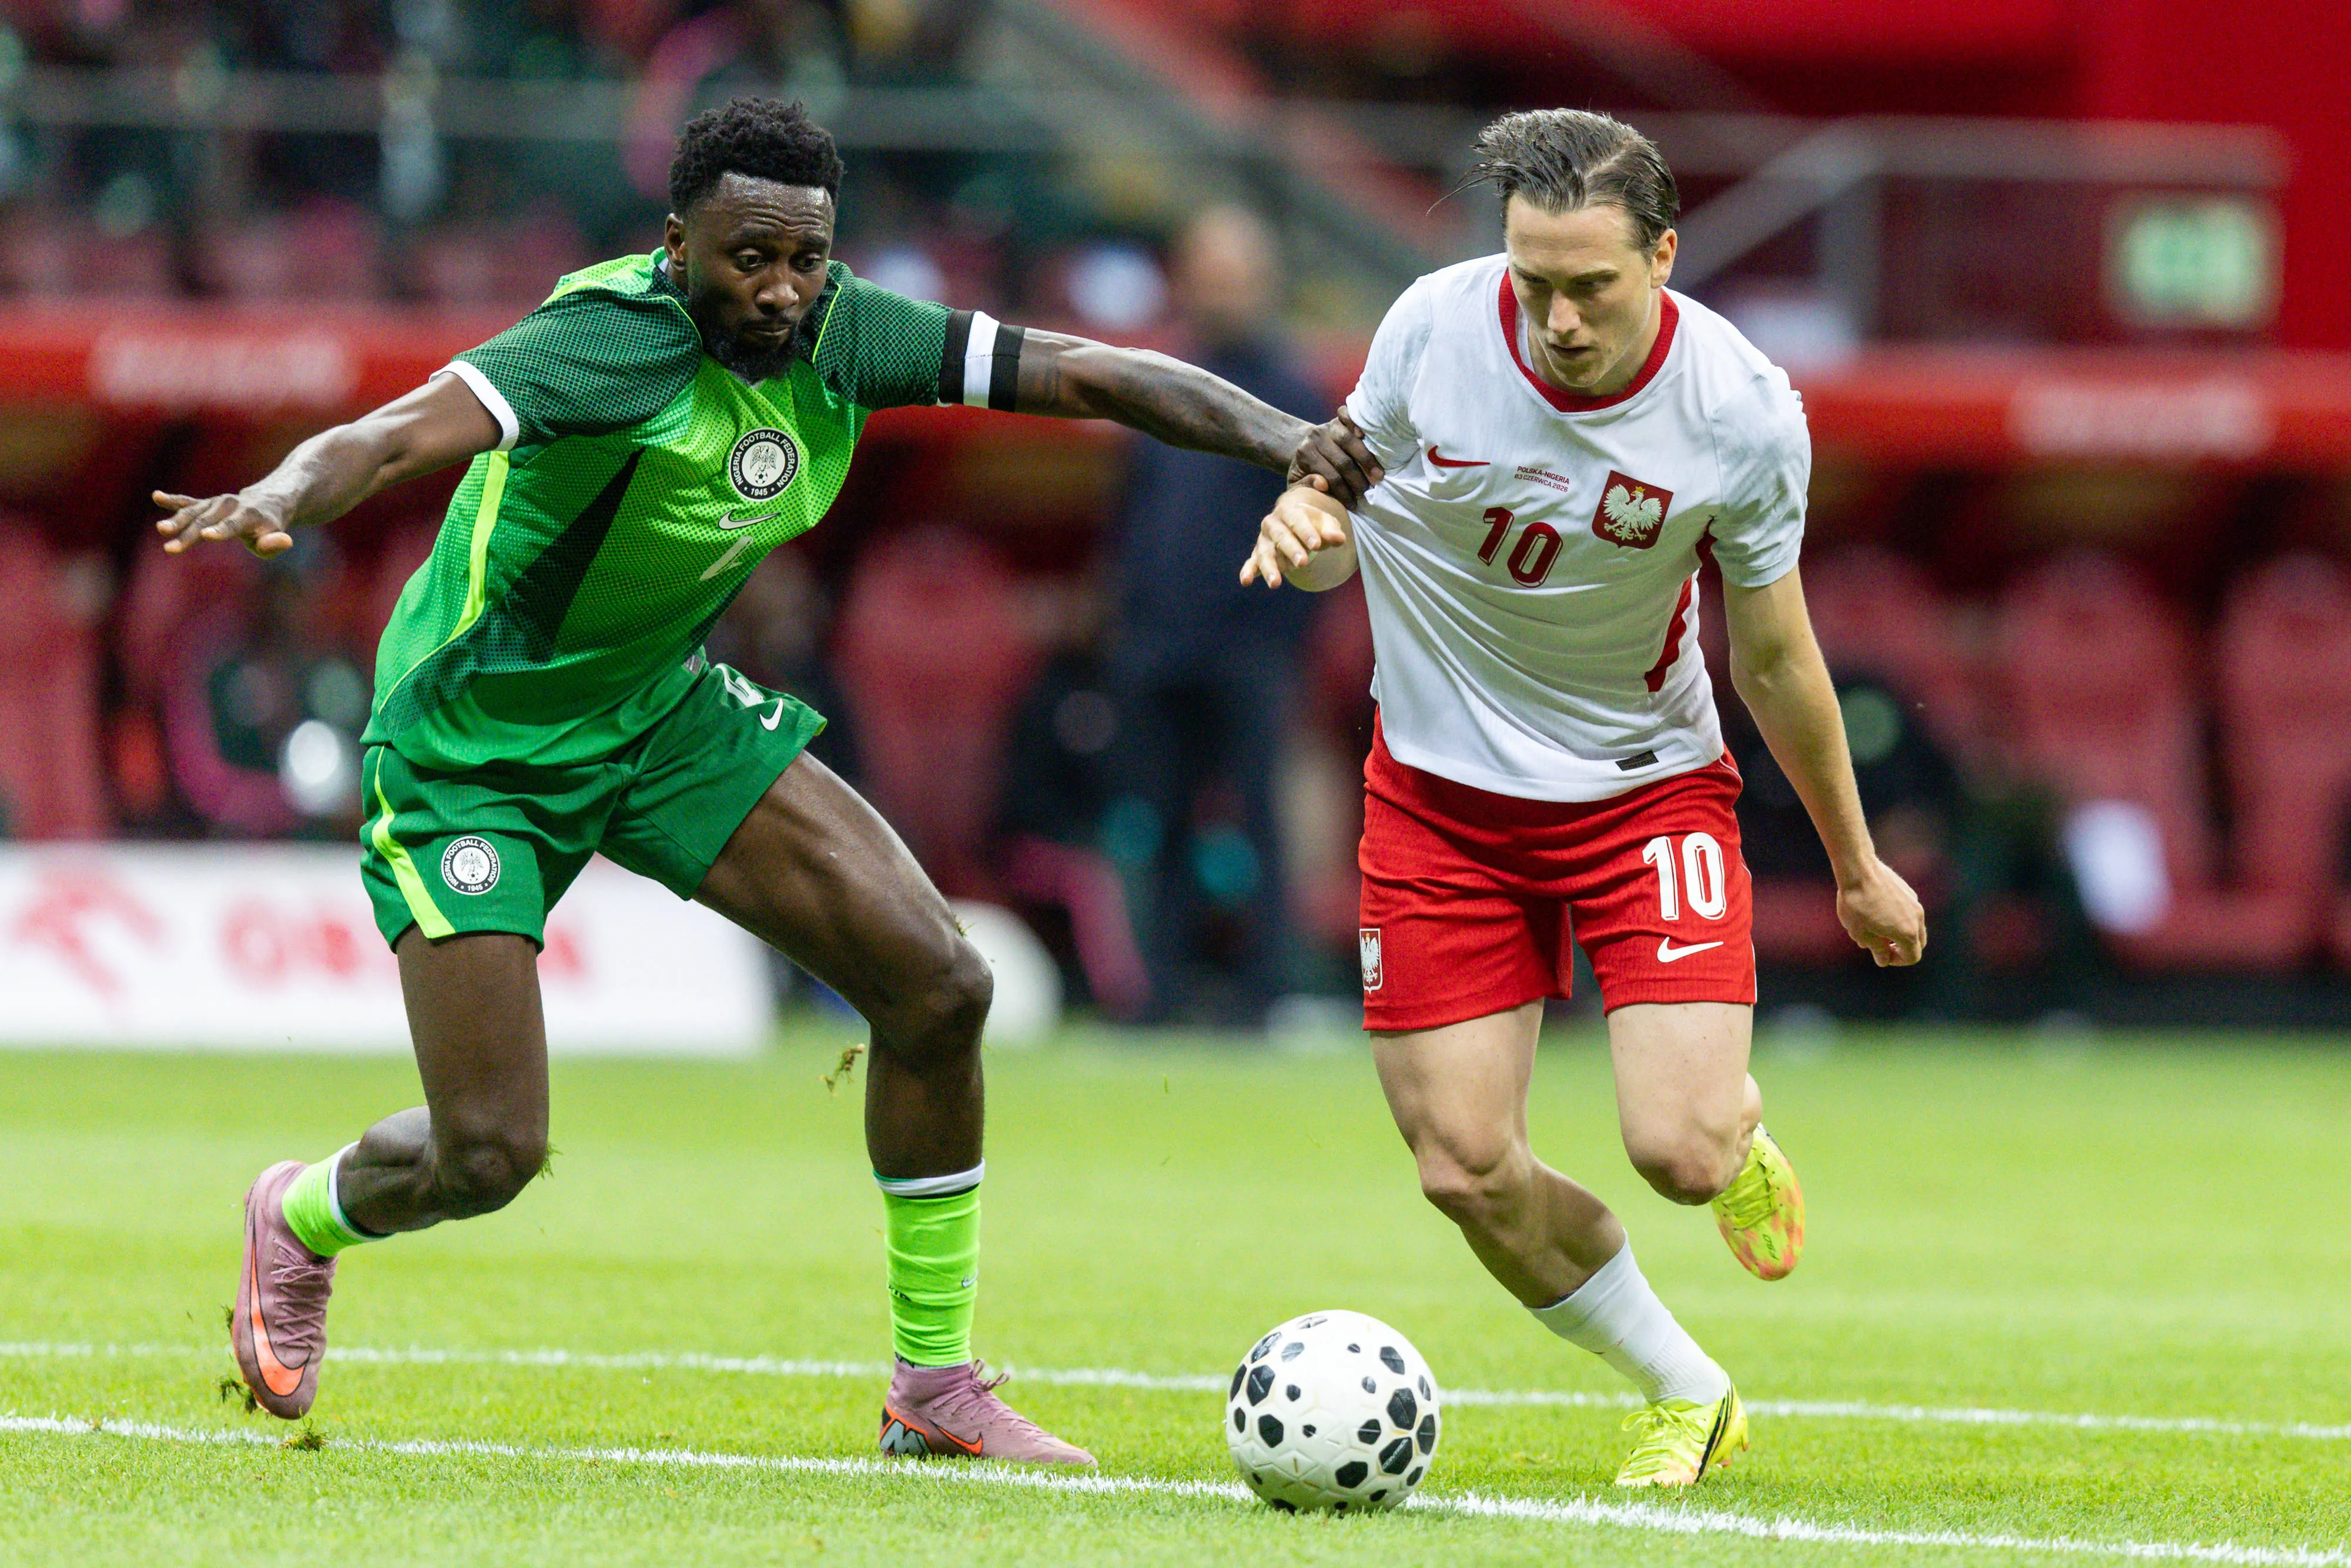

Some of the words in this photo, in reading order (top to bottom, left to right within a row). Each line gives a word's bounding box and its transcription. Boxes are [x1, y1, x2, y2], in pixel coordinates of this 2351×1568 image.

[733, 451, 744, 485] NIGERIA
[739, 432, 781, 451] FOOTBALL
[777, 438, 795, 488] FEDERATION
[1517, 466, 1569, 484] POLSKA-NIGERIA
[1523, 475, 1552, 487] CZERWCA
[1552, 483, 1569, 492] 2026
[751, 488, 768, 496] 1945
[1478, 507, 1563, 588] 10
[446, 839, 479, 860] FOOTBALL
[480, 842, 497, 883] FEDERATION
[444, 860, 458, 887] NIGERIA
[1642, 832, 1727, 922] 10
